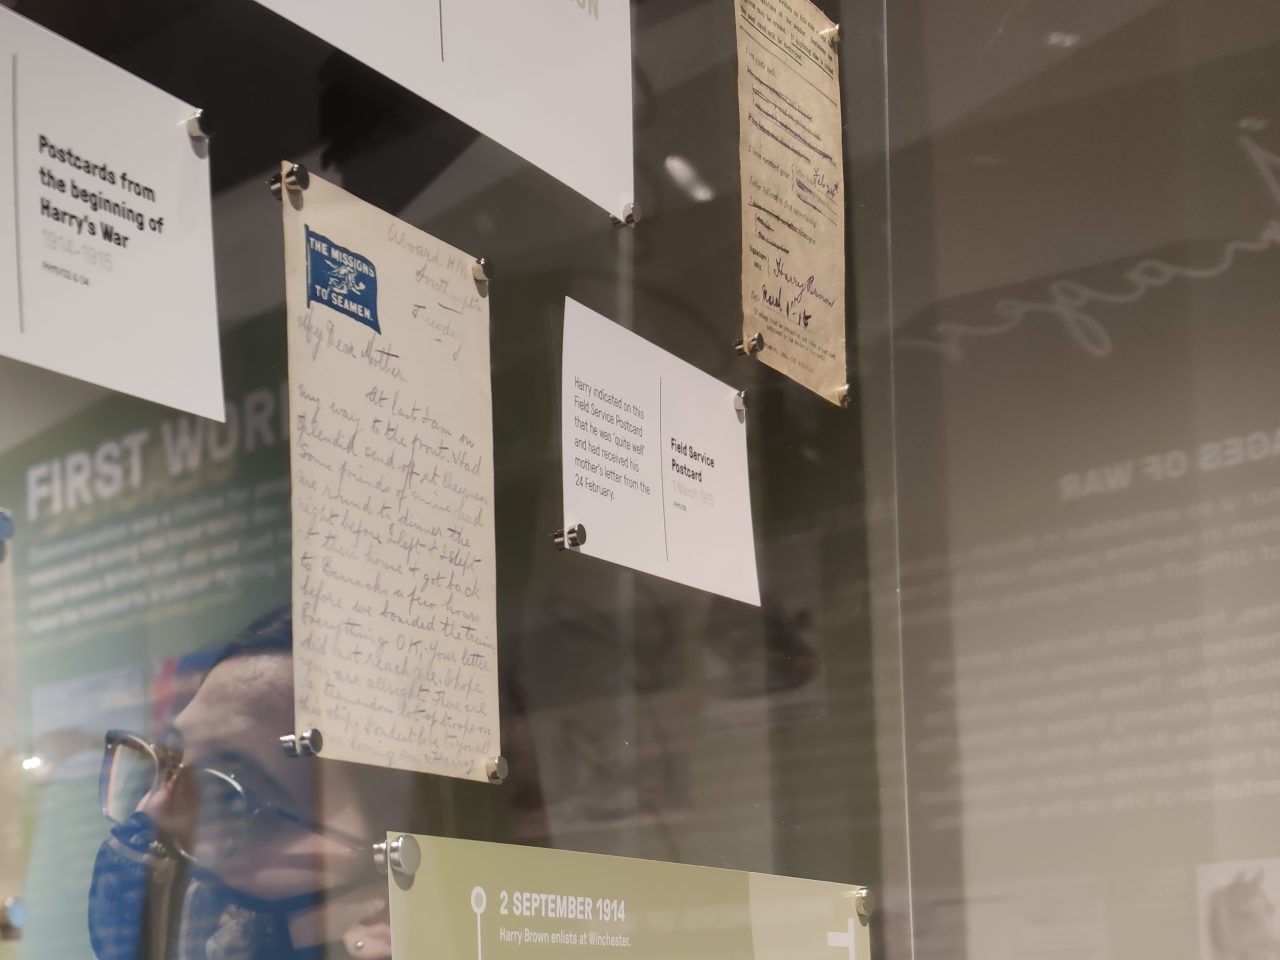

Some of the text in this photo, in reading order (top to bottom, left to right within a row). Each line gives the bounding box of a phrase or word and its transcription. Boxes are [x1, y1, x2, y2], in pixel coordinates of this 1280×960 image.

[39, 135, 155, 202] Postcards from
[39, 168, 164, 234] the beginning of
[41, 198, 129, 248] Harry's War
[309, 236, 375, 277] THE MISSIONS
[315, 284, 374, 321] TO SEAMEN.
[574, 376, 645, 420] Harry indicated on this
[574, 395, 643, 438] Field Service Postcard
[574, 416, 589, 433] that
[590, 422, 598, 437] he
[600, 430, 612, 443] was
[26, 382, 290, 521] FIRST WOR
[575, 437, 640, 473] and had received his
[671, 438, 715, 468] Field Service
[575, 473, 615, 501] 24 February.
[605, 467, 623, 483] letter
[623, 474, 639, 490] from
[640, 482, 651, 495] the
[672, 458, 702, 483] Postcard
[500, 890, 626, 922] 2 SEPTEMBER 1914
[500, 927, 632, 947] Harry Brown enlists at Winchester.
